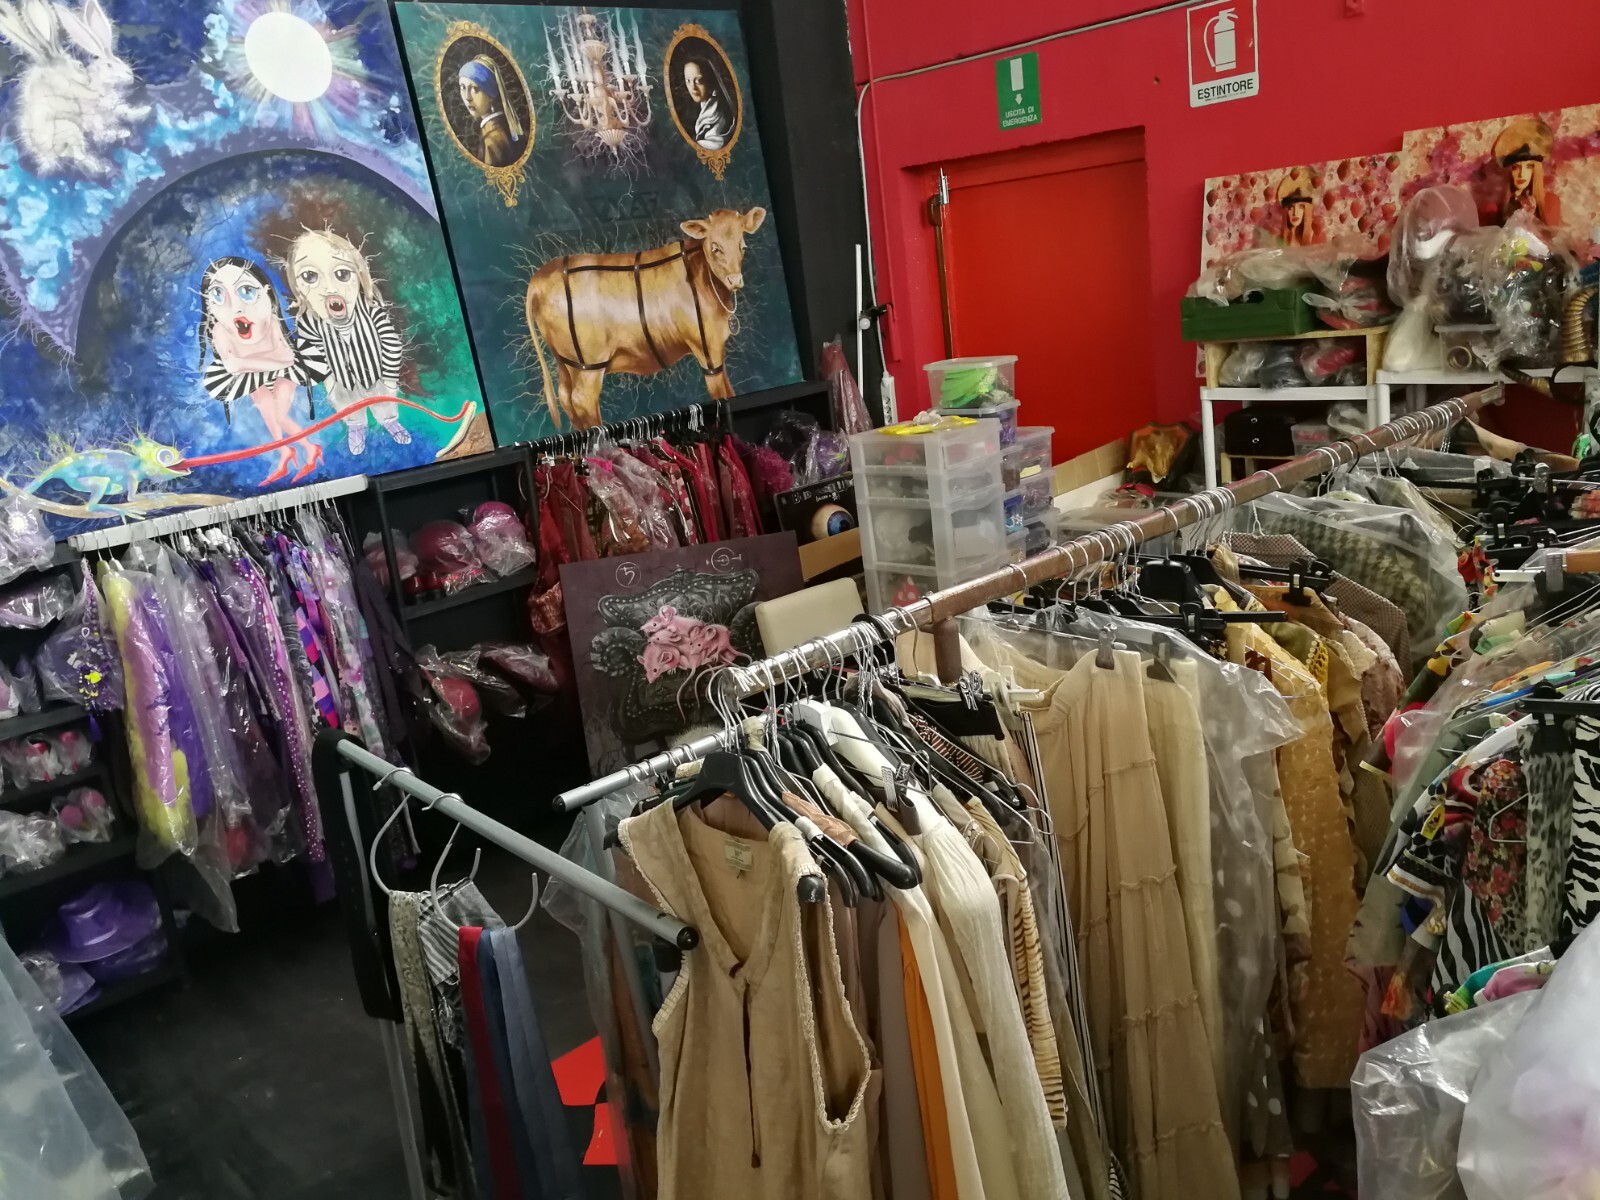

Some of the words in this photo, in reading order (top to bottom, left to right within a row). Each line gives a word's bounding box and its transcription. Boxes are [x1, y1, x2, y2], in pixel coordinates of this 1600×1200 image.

[1197, 78, 1254, 100] ESTINTORE
[1005, 107, 1026, 119] USCITA
[1027, 105, 1035, 114] DI
[1002, 113, 1038, 128] EMERGENZA
